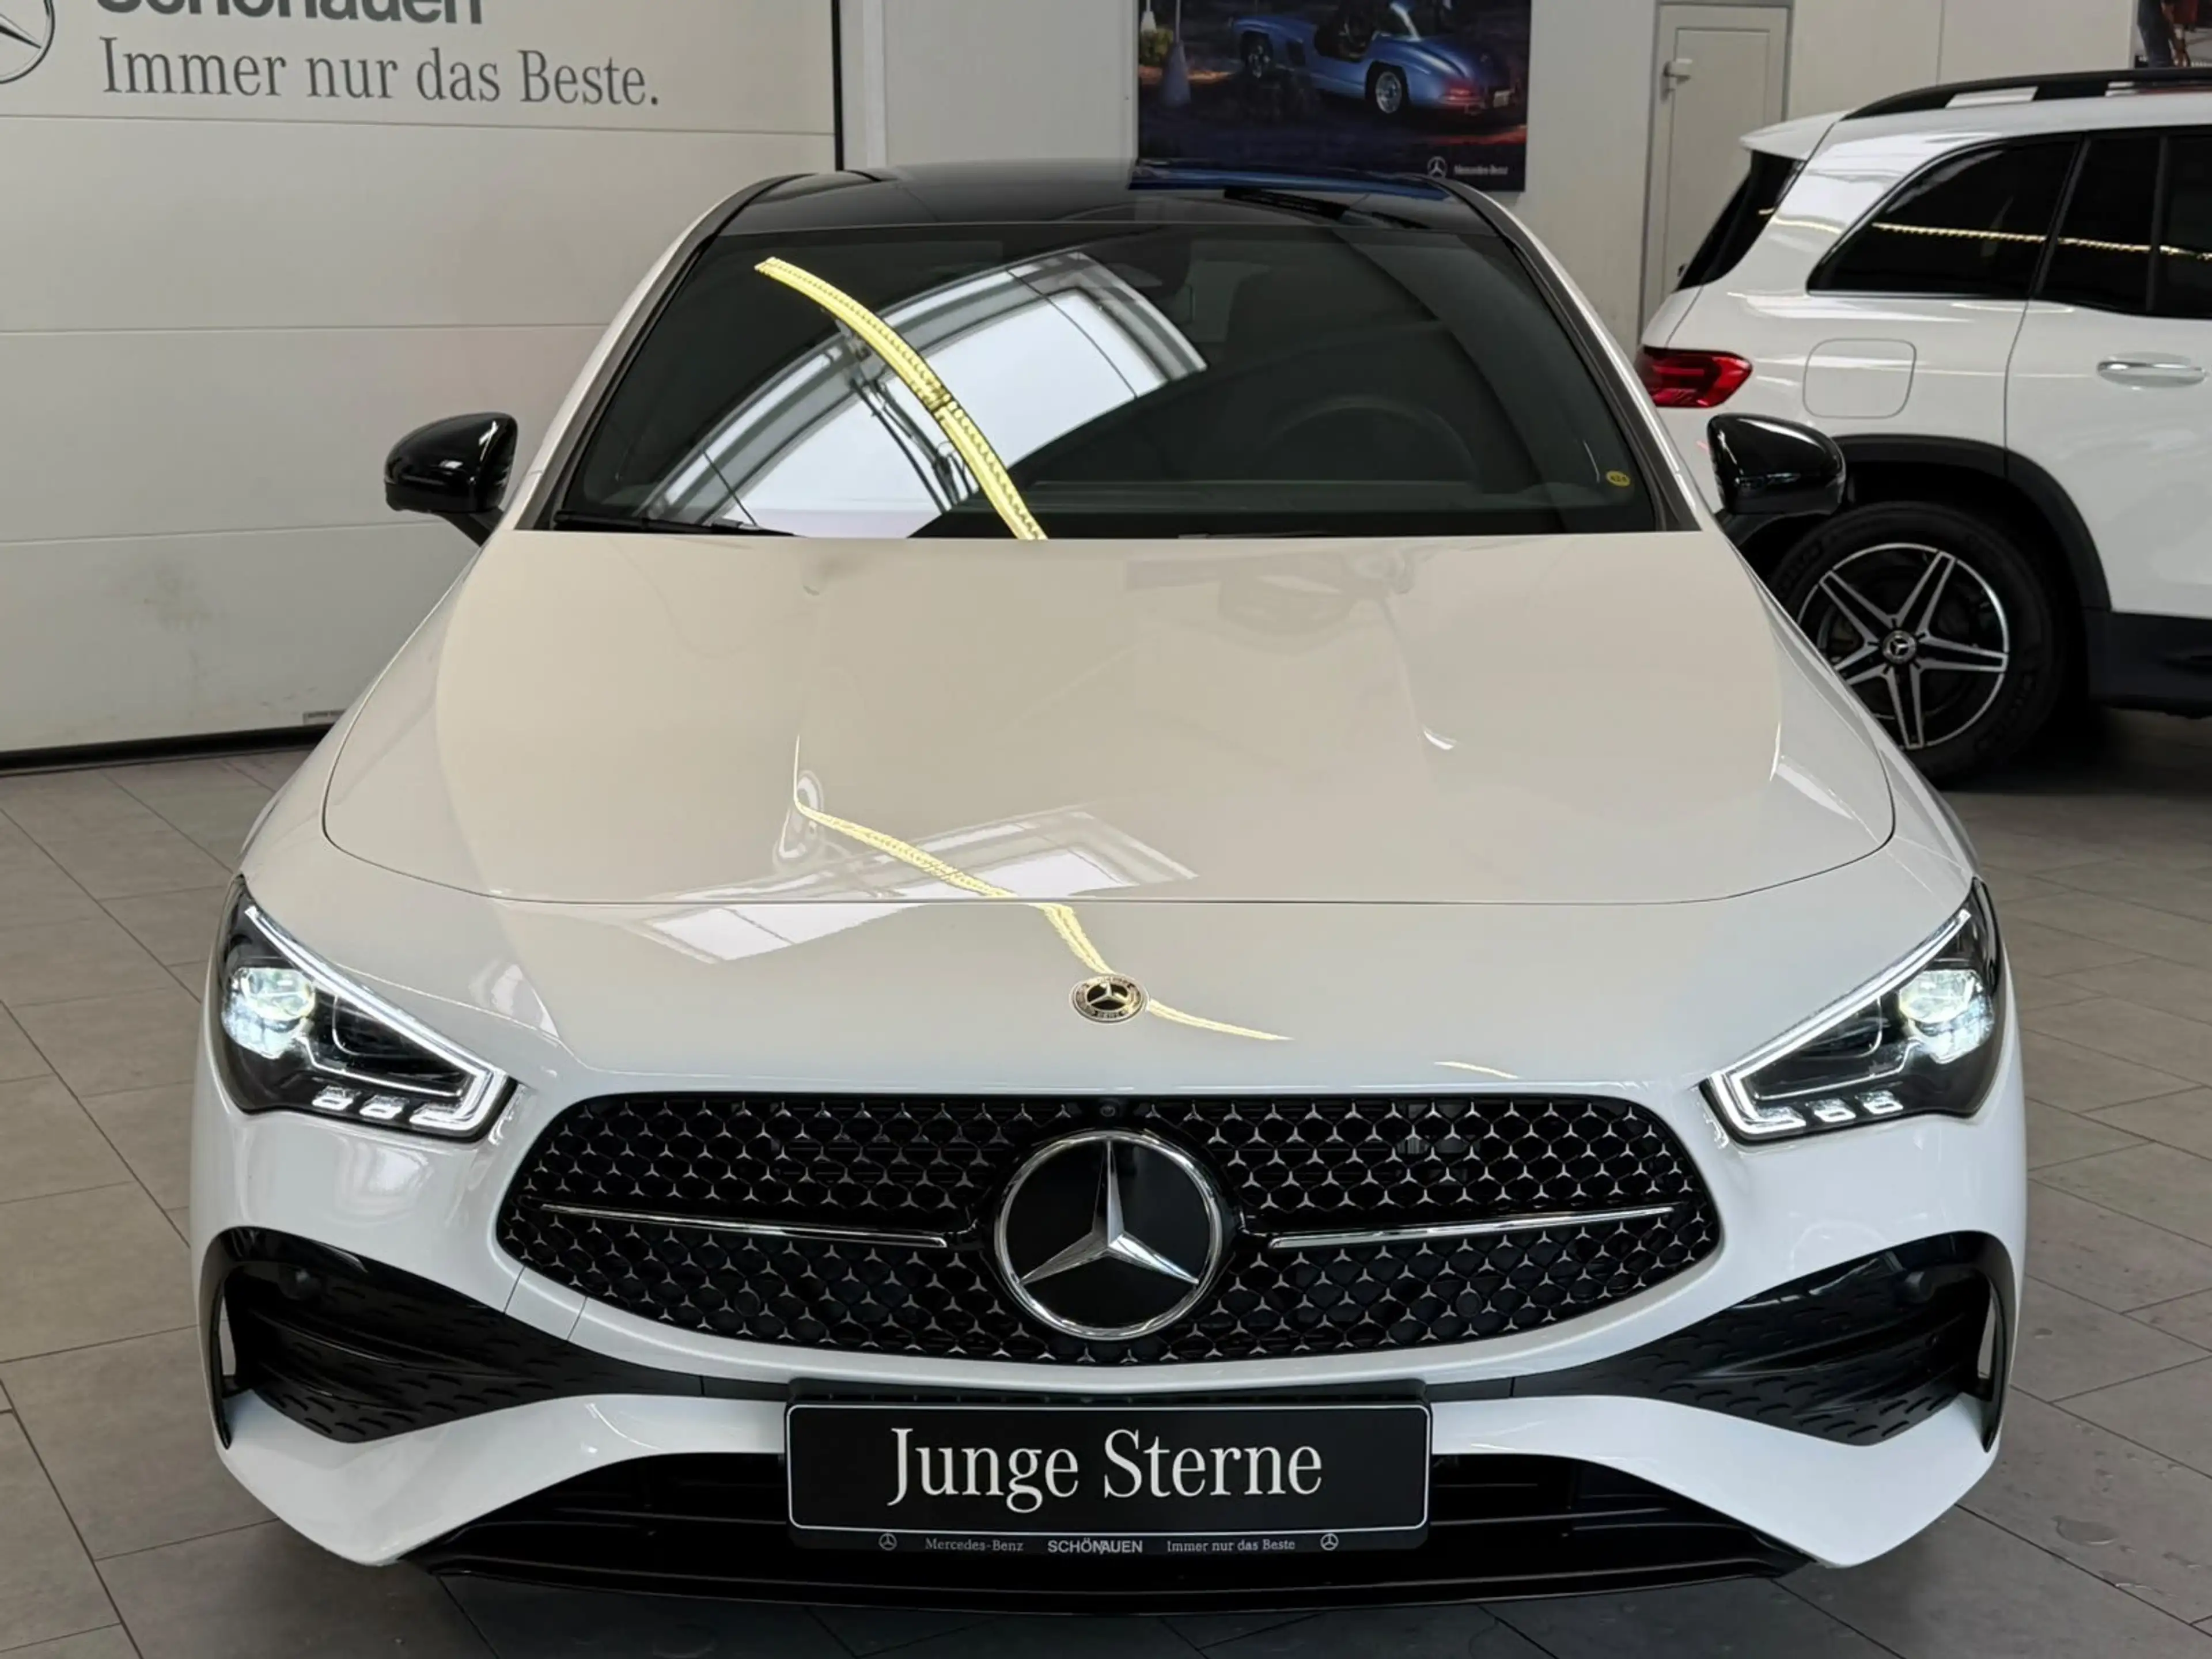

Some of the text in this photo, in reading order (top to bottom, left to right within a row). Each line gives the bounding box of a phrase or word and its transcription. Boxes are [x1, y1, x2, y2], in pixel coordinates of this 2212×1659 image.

[99, 36, 658, 105] Immer nur das Beste.
[887, 1427, 1321, 1513] Junge Sterne
[925, 1537, 1296, 1555] Mercedes-Benz SCHÖNAUEN Immer nur das Beste
